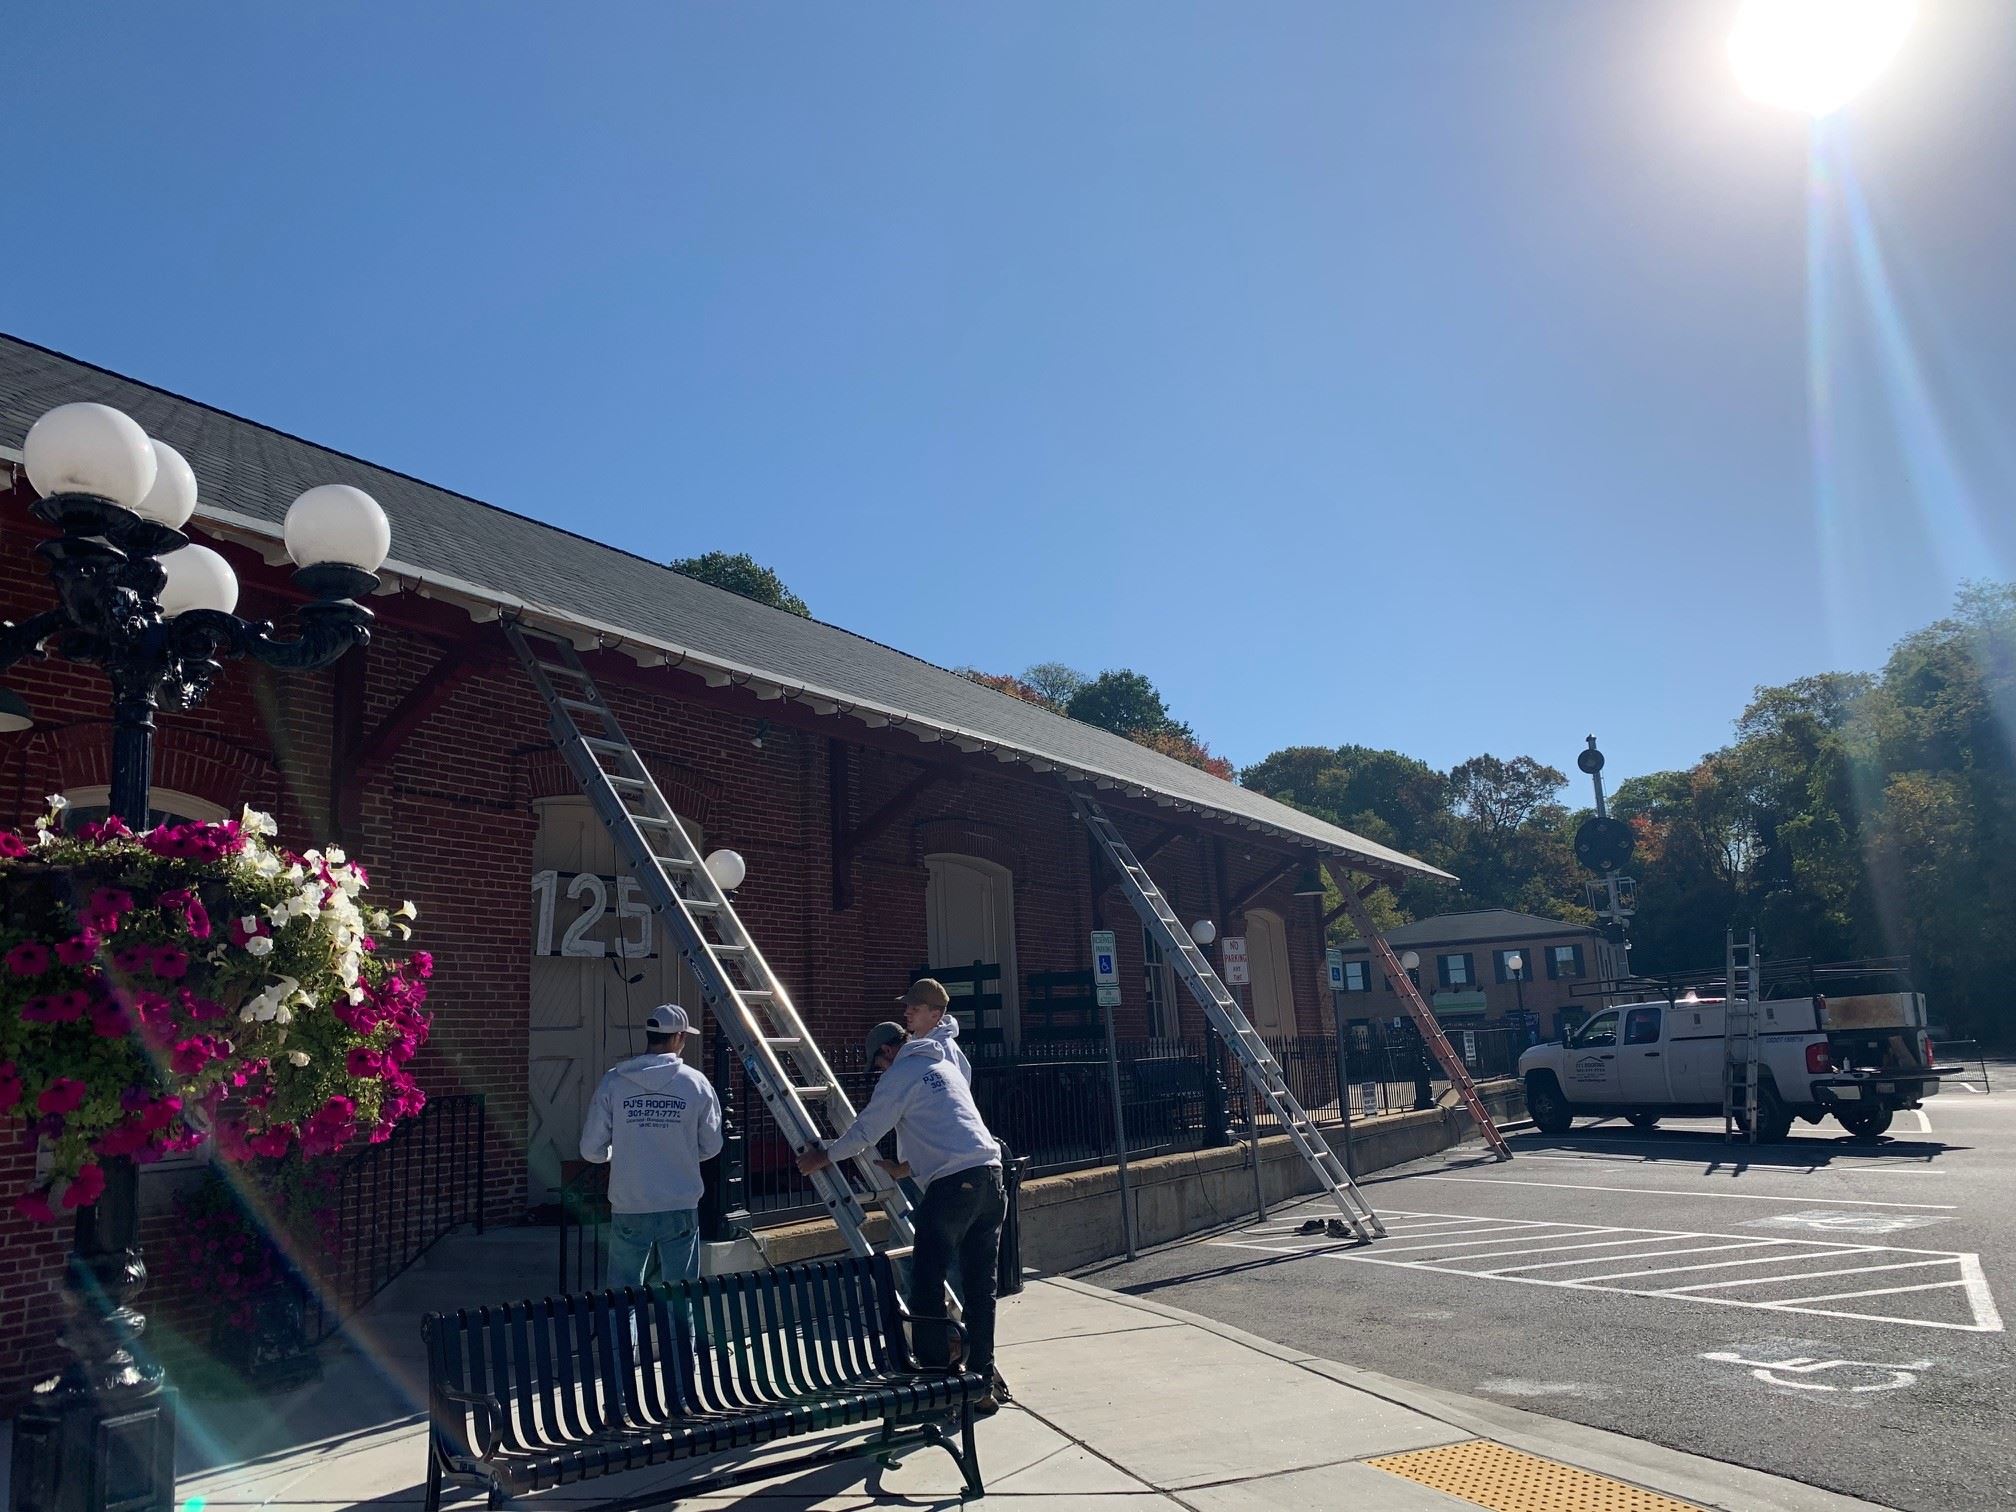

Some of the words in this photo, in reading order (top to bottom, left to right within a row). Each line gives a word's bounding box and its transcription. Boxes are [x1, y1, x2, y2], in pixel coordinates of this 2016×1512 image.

[531, 869, 653, 958] 125
[1229, 940, 1239, 951] NO
[1224, 953, 1248, 962] PARKING
[922, 1072, 942, 1085] PJ'S
[623, 1100, 643, 1109] PJ'S
[645, 1100, 687, 1110] ROOFING
